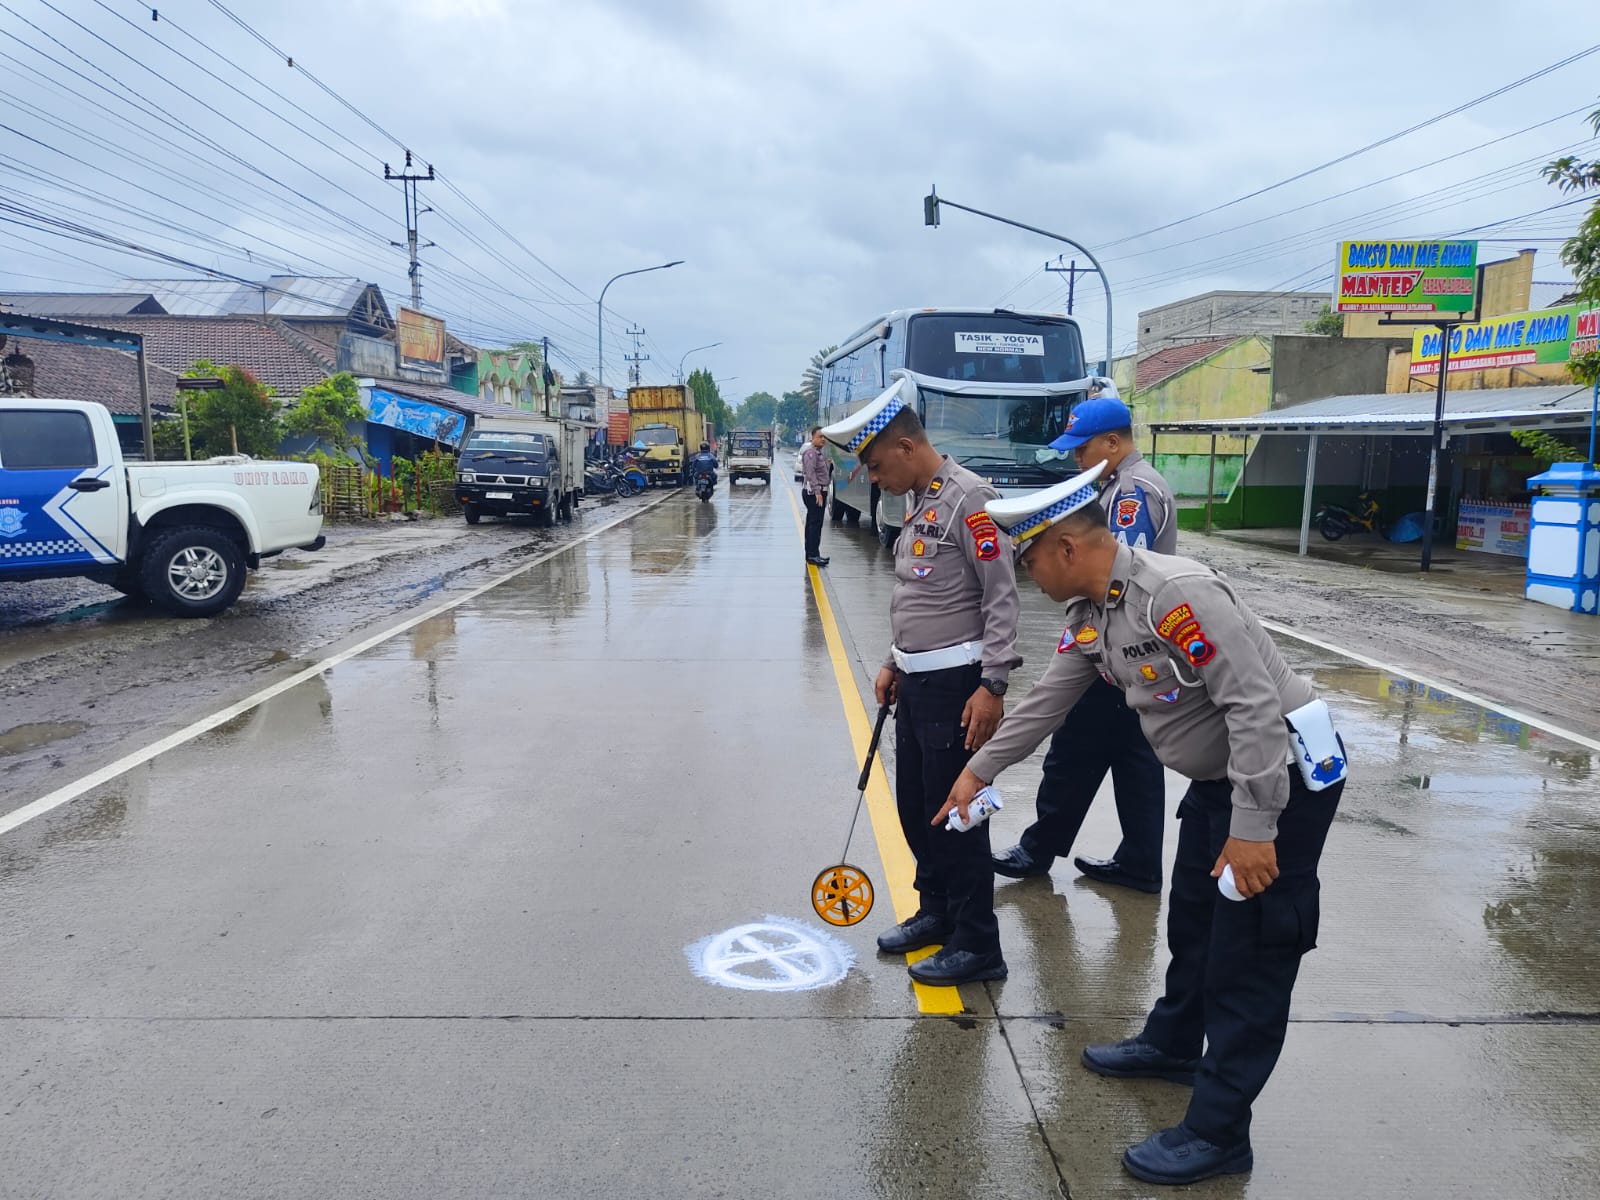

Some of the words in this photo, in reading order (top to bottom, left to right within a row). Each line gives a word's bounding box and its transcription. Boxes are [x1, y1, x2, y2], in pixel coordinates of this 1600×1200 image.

[1348, 243, 1388, 269] BAKSO
[1389, 243, 1415, 268] DAN
[1415, 243, 1440, 268] MIE
[1440, 243, 1473, 268] AYAM
[1340, 275, 1415, 298] MANTEP
[1464, 326, 1494, 352] DAN
[1494, 320, 1526, 347] MIE
[1525, 314, 1570, 345] AYAM
[1575, 312, 1600, 338] MA
[960, 334, 992, 342] TASIK
[1003, 335, 1039, 344] YOGYA
[234, 472, 269, 486] UNIT
[272, 471, 308, 486] LAKA
[1122, 640, 1160, 659] POLRI
